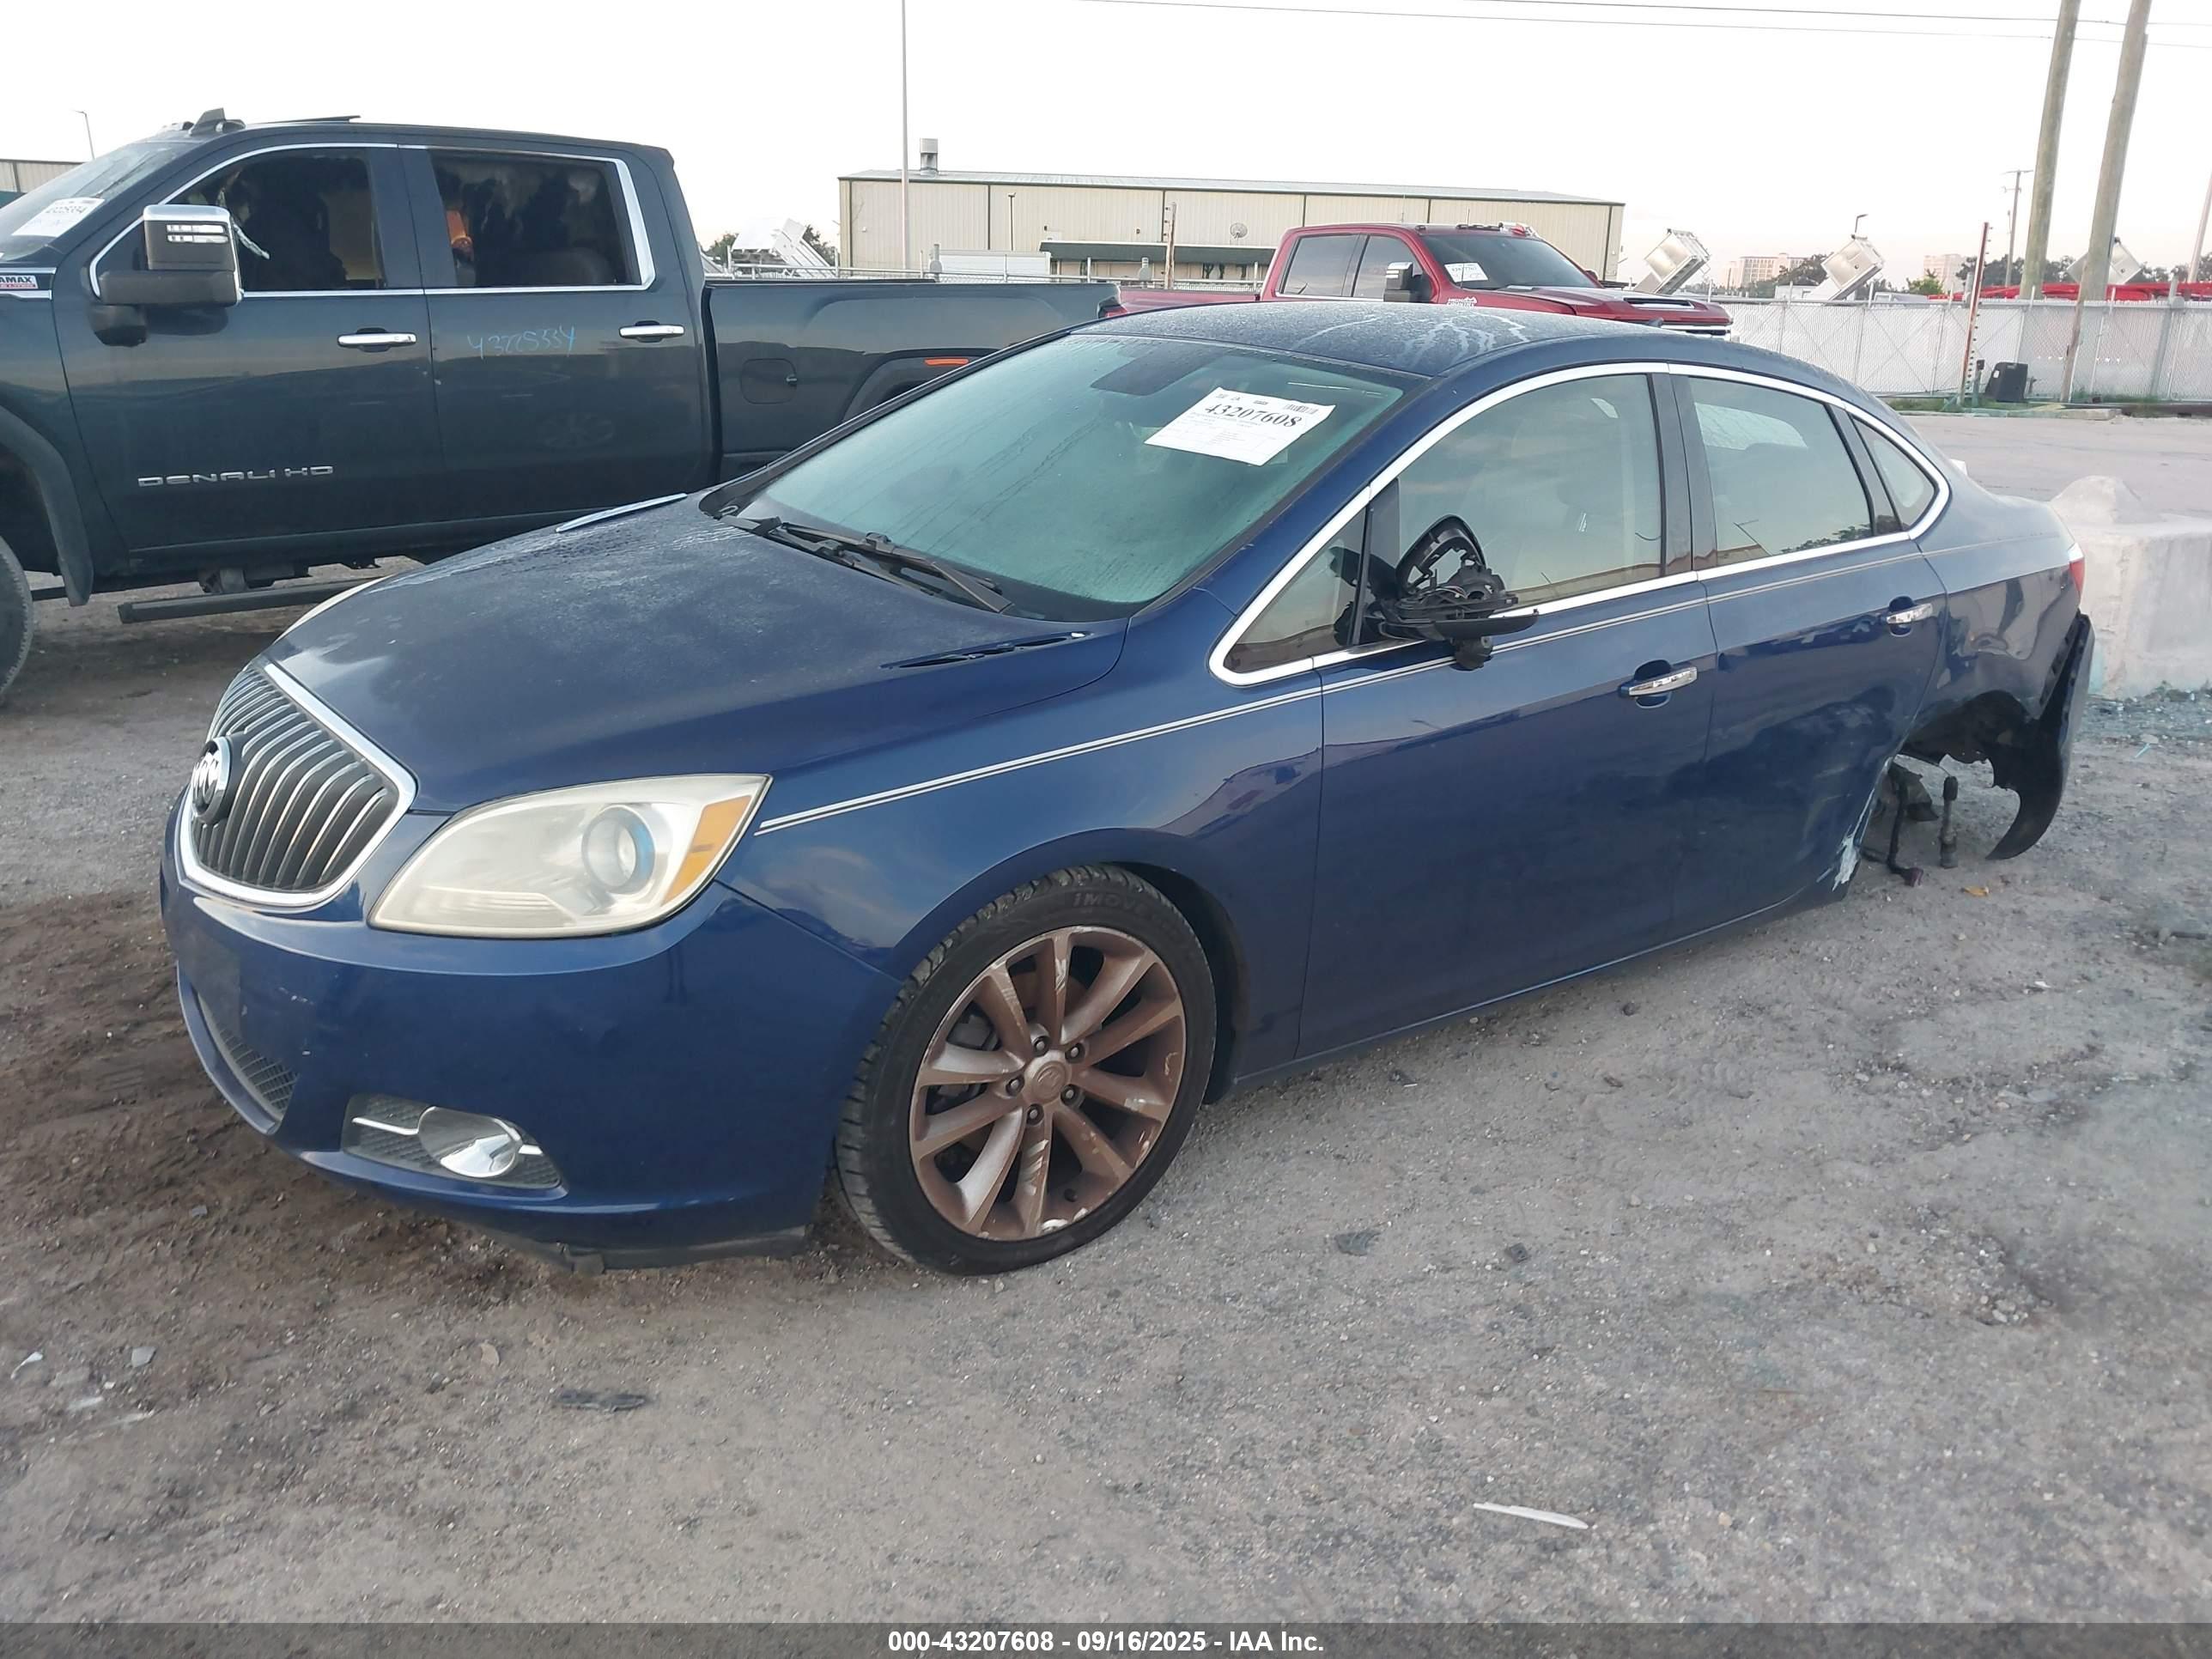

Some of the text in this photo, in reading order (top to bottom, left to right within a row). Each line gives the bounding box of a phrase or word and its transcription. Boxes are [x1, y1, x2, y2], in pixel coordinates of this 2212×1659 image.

[1205, 403, 1303, 428] 43207608
[137, 465, 334, 487] DENALI HD
